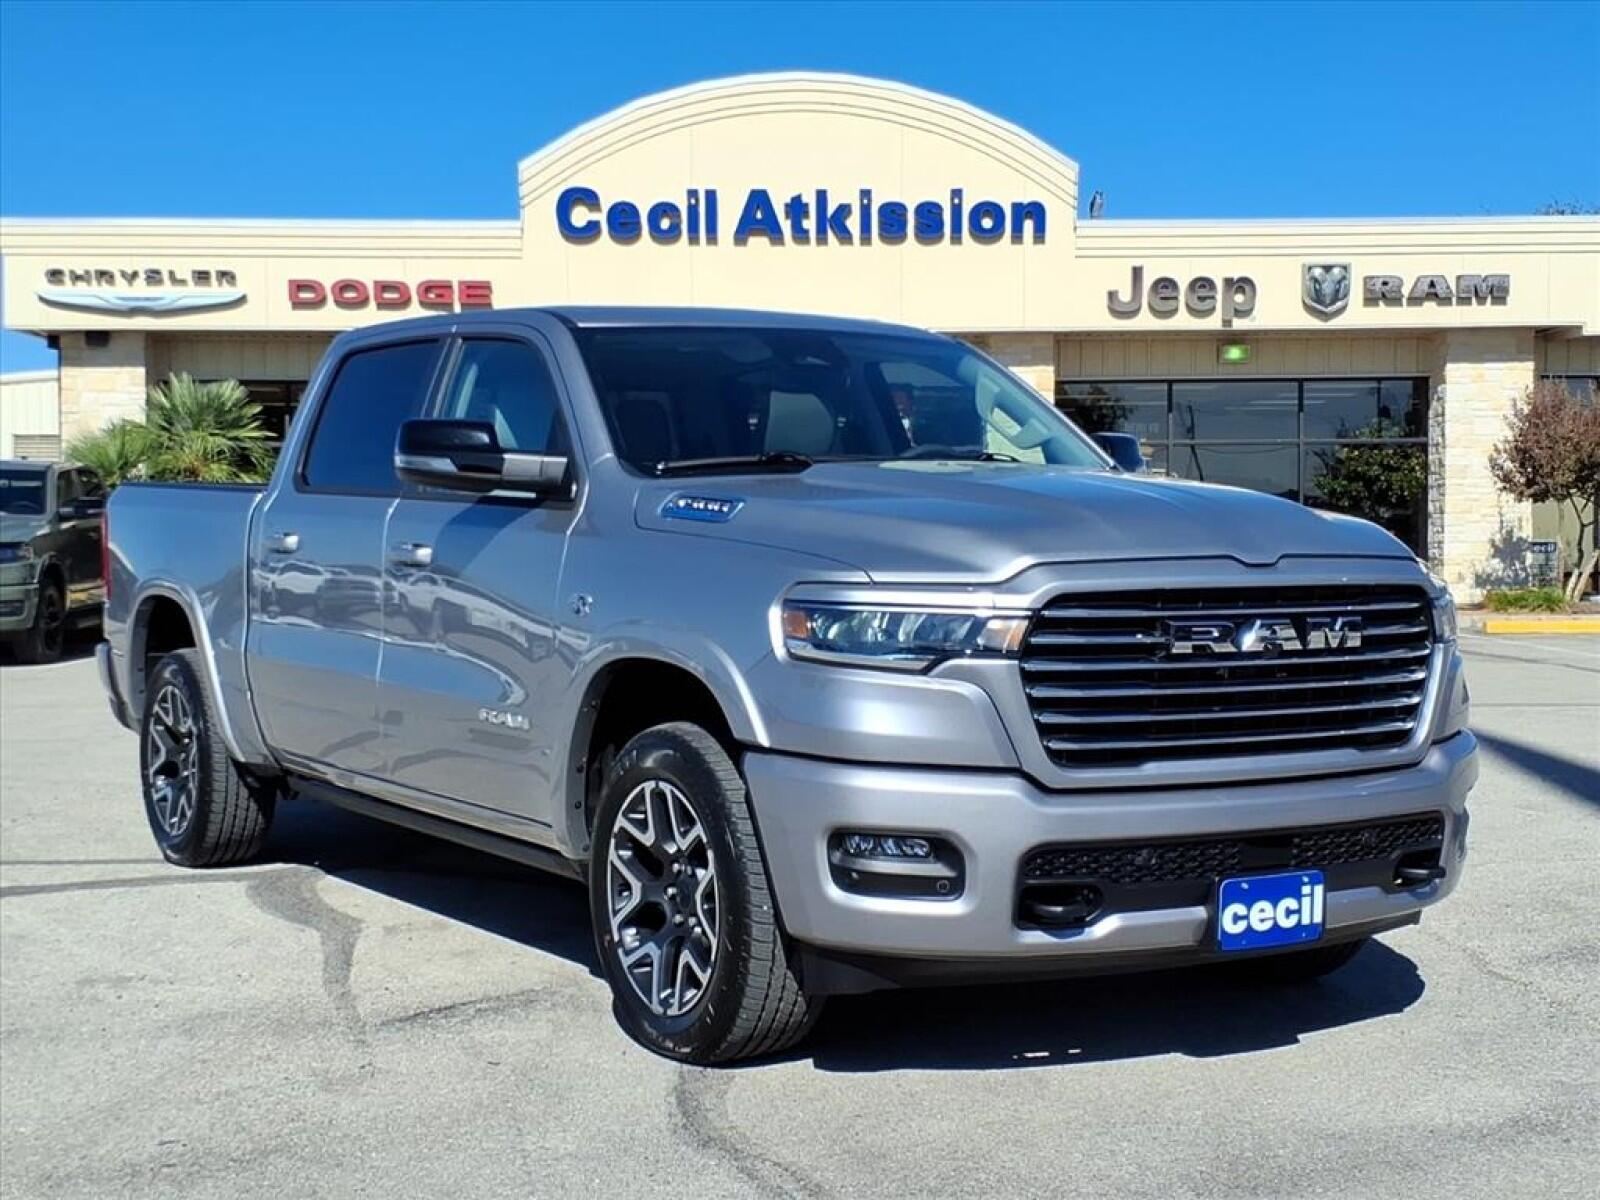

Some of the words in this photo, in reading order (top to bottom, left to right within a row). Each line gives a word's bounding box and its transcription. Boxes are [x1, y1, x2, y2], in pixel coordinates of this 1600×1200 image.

[556, 186, 718, 245] Cecil
[734, 188, 1047, 246] Atkission
[45, 268, 237, 287] CHRYSLER
[288, 279, 493, 310] DODGE
[1107, 265, 1257, 327] Jeep
[1363, 274, 1510, 307] RAM
[1168, 616, 1362, 653] RAM
[1222, 883, 1324, 934] cecil
